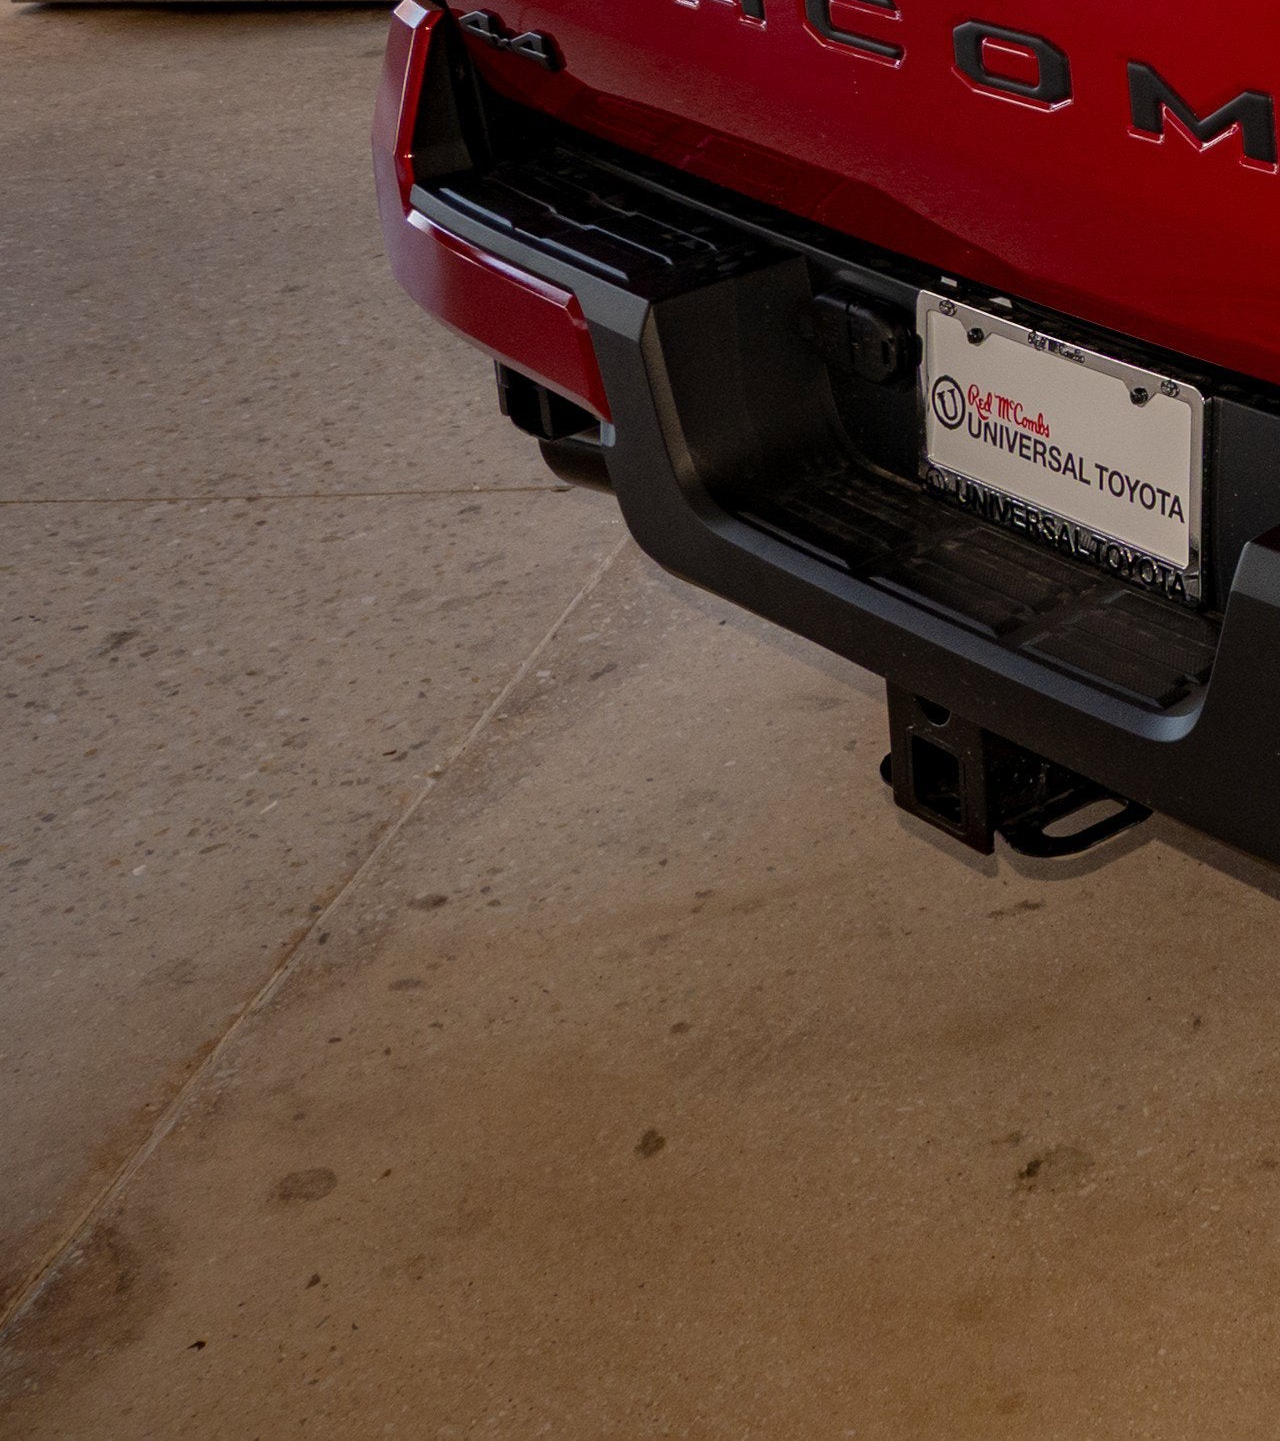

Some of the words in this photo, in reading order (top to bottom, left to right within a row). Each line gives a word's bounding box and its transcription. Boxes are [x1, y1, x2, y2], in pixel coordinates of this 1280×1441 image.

[968, 384, 993, 421] Red
[995, 392, 1050, 438] McCombs
[968, 412, 1091, 485] UNIVERSAL
[1095, 463, 1185, 523] TOYOTA
[956, 476, 1091, 557] UNIVERSAL
[1091, 536, 1189, 601] TOYOTA
